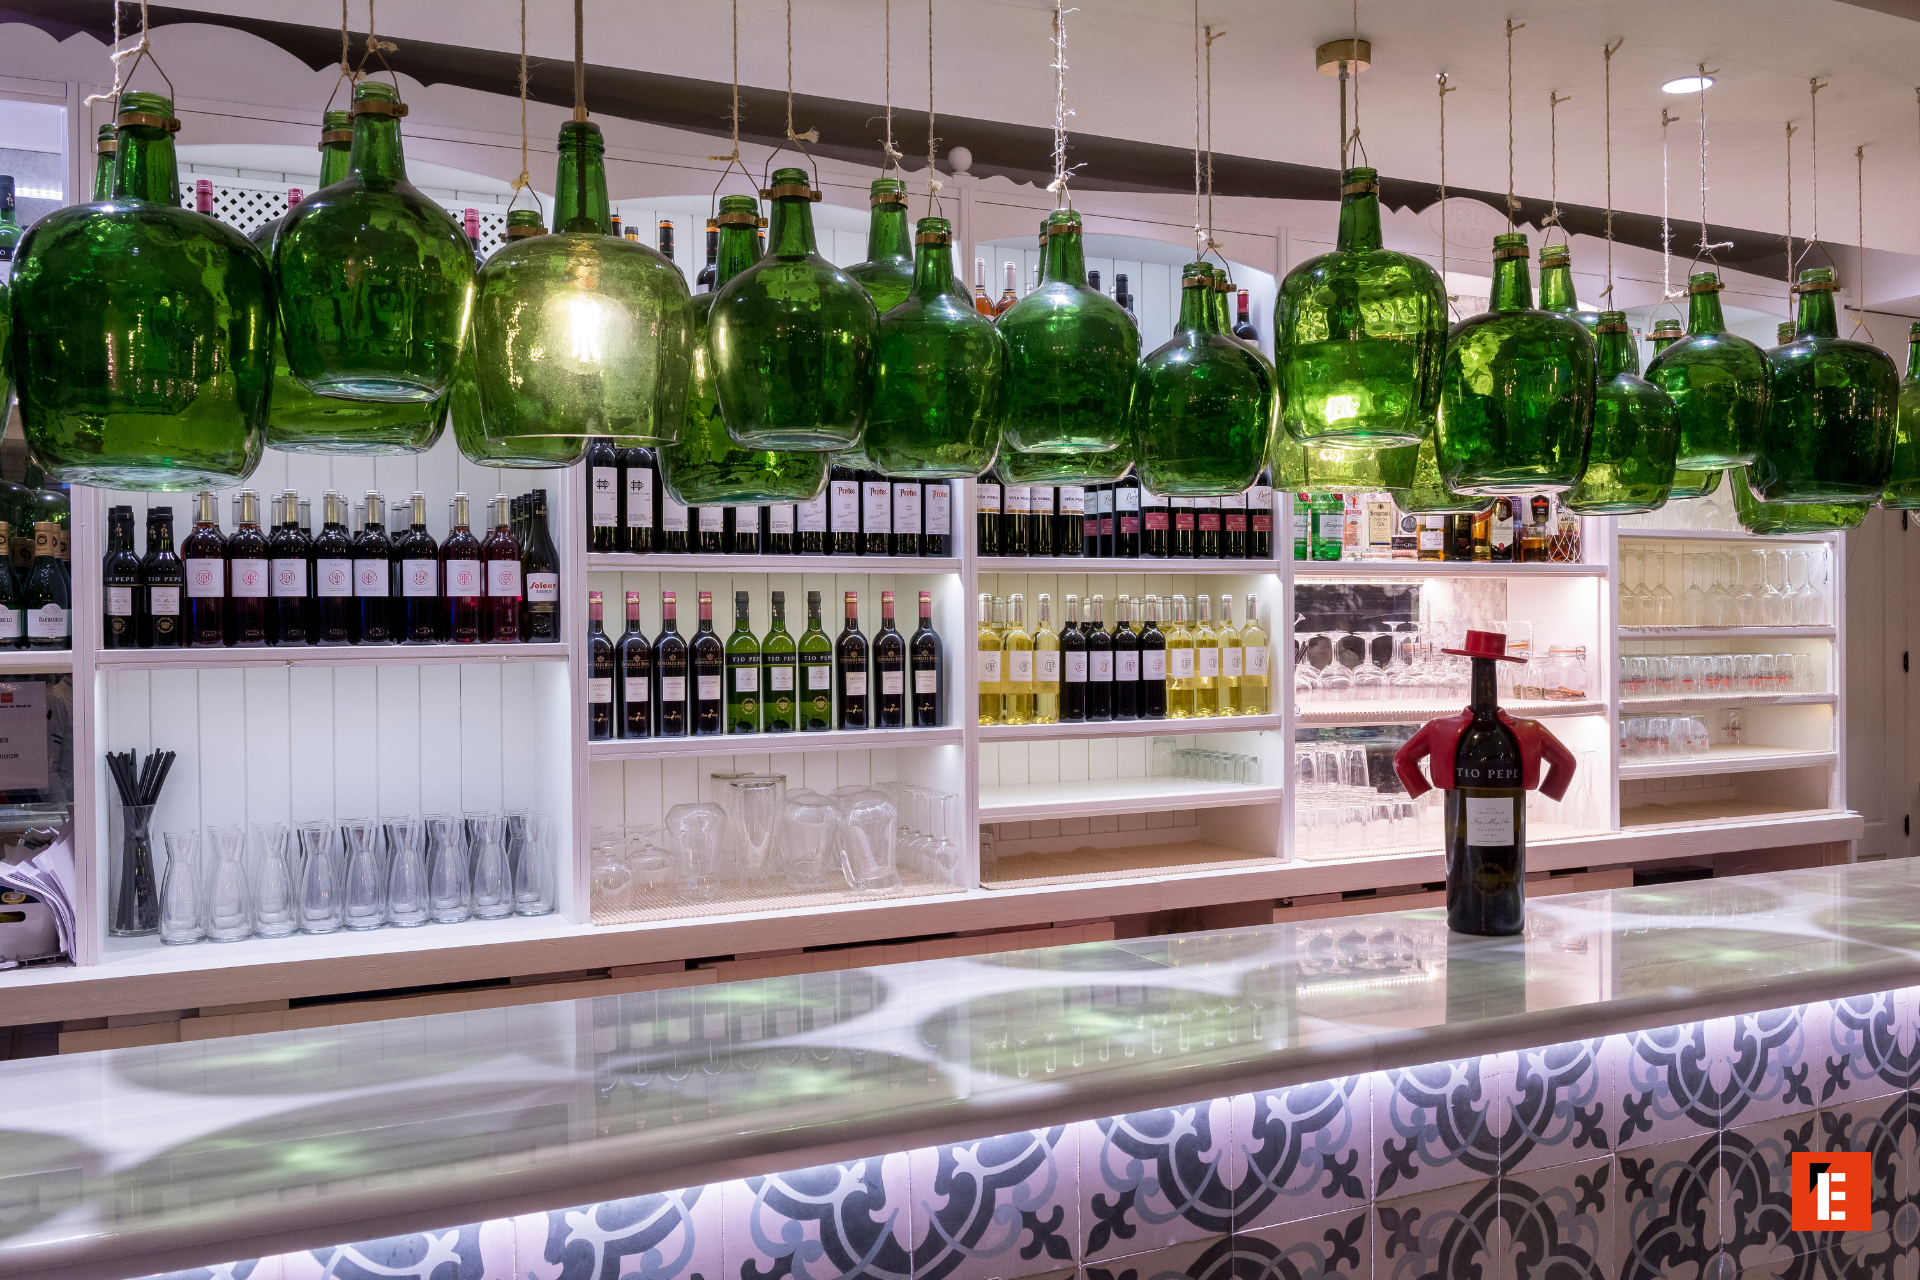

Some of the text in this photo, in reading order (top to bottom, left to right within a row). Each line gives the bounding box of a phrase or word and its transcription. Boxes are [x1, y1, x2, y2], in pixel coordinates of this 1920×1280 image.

[1446, 205, 1492, 225] JEREZ
[1452, 226, 1487, 244] 1872
[837, 486, 855, 496] Protos
[869, 487, 887, 497] Protos
[899, 488, 917, 498] Protos
[529, 581, 557, 589] Solear
[1456, 767, 1519, 779] TIO PEPE
